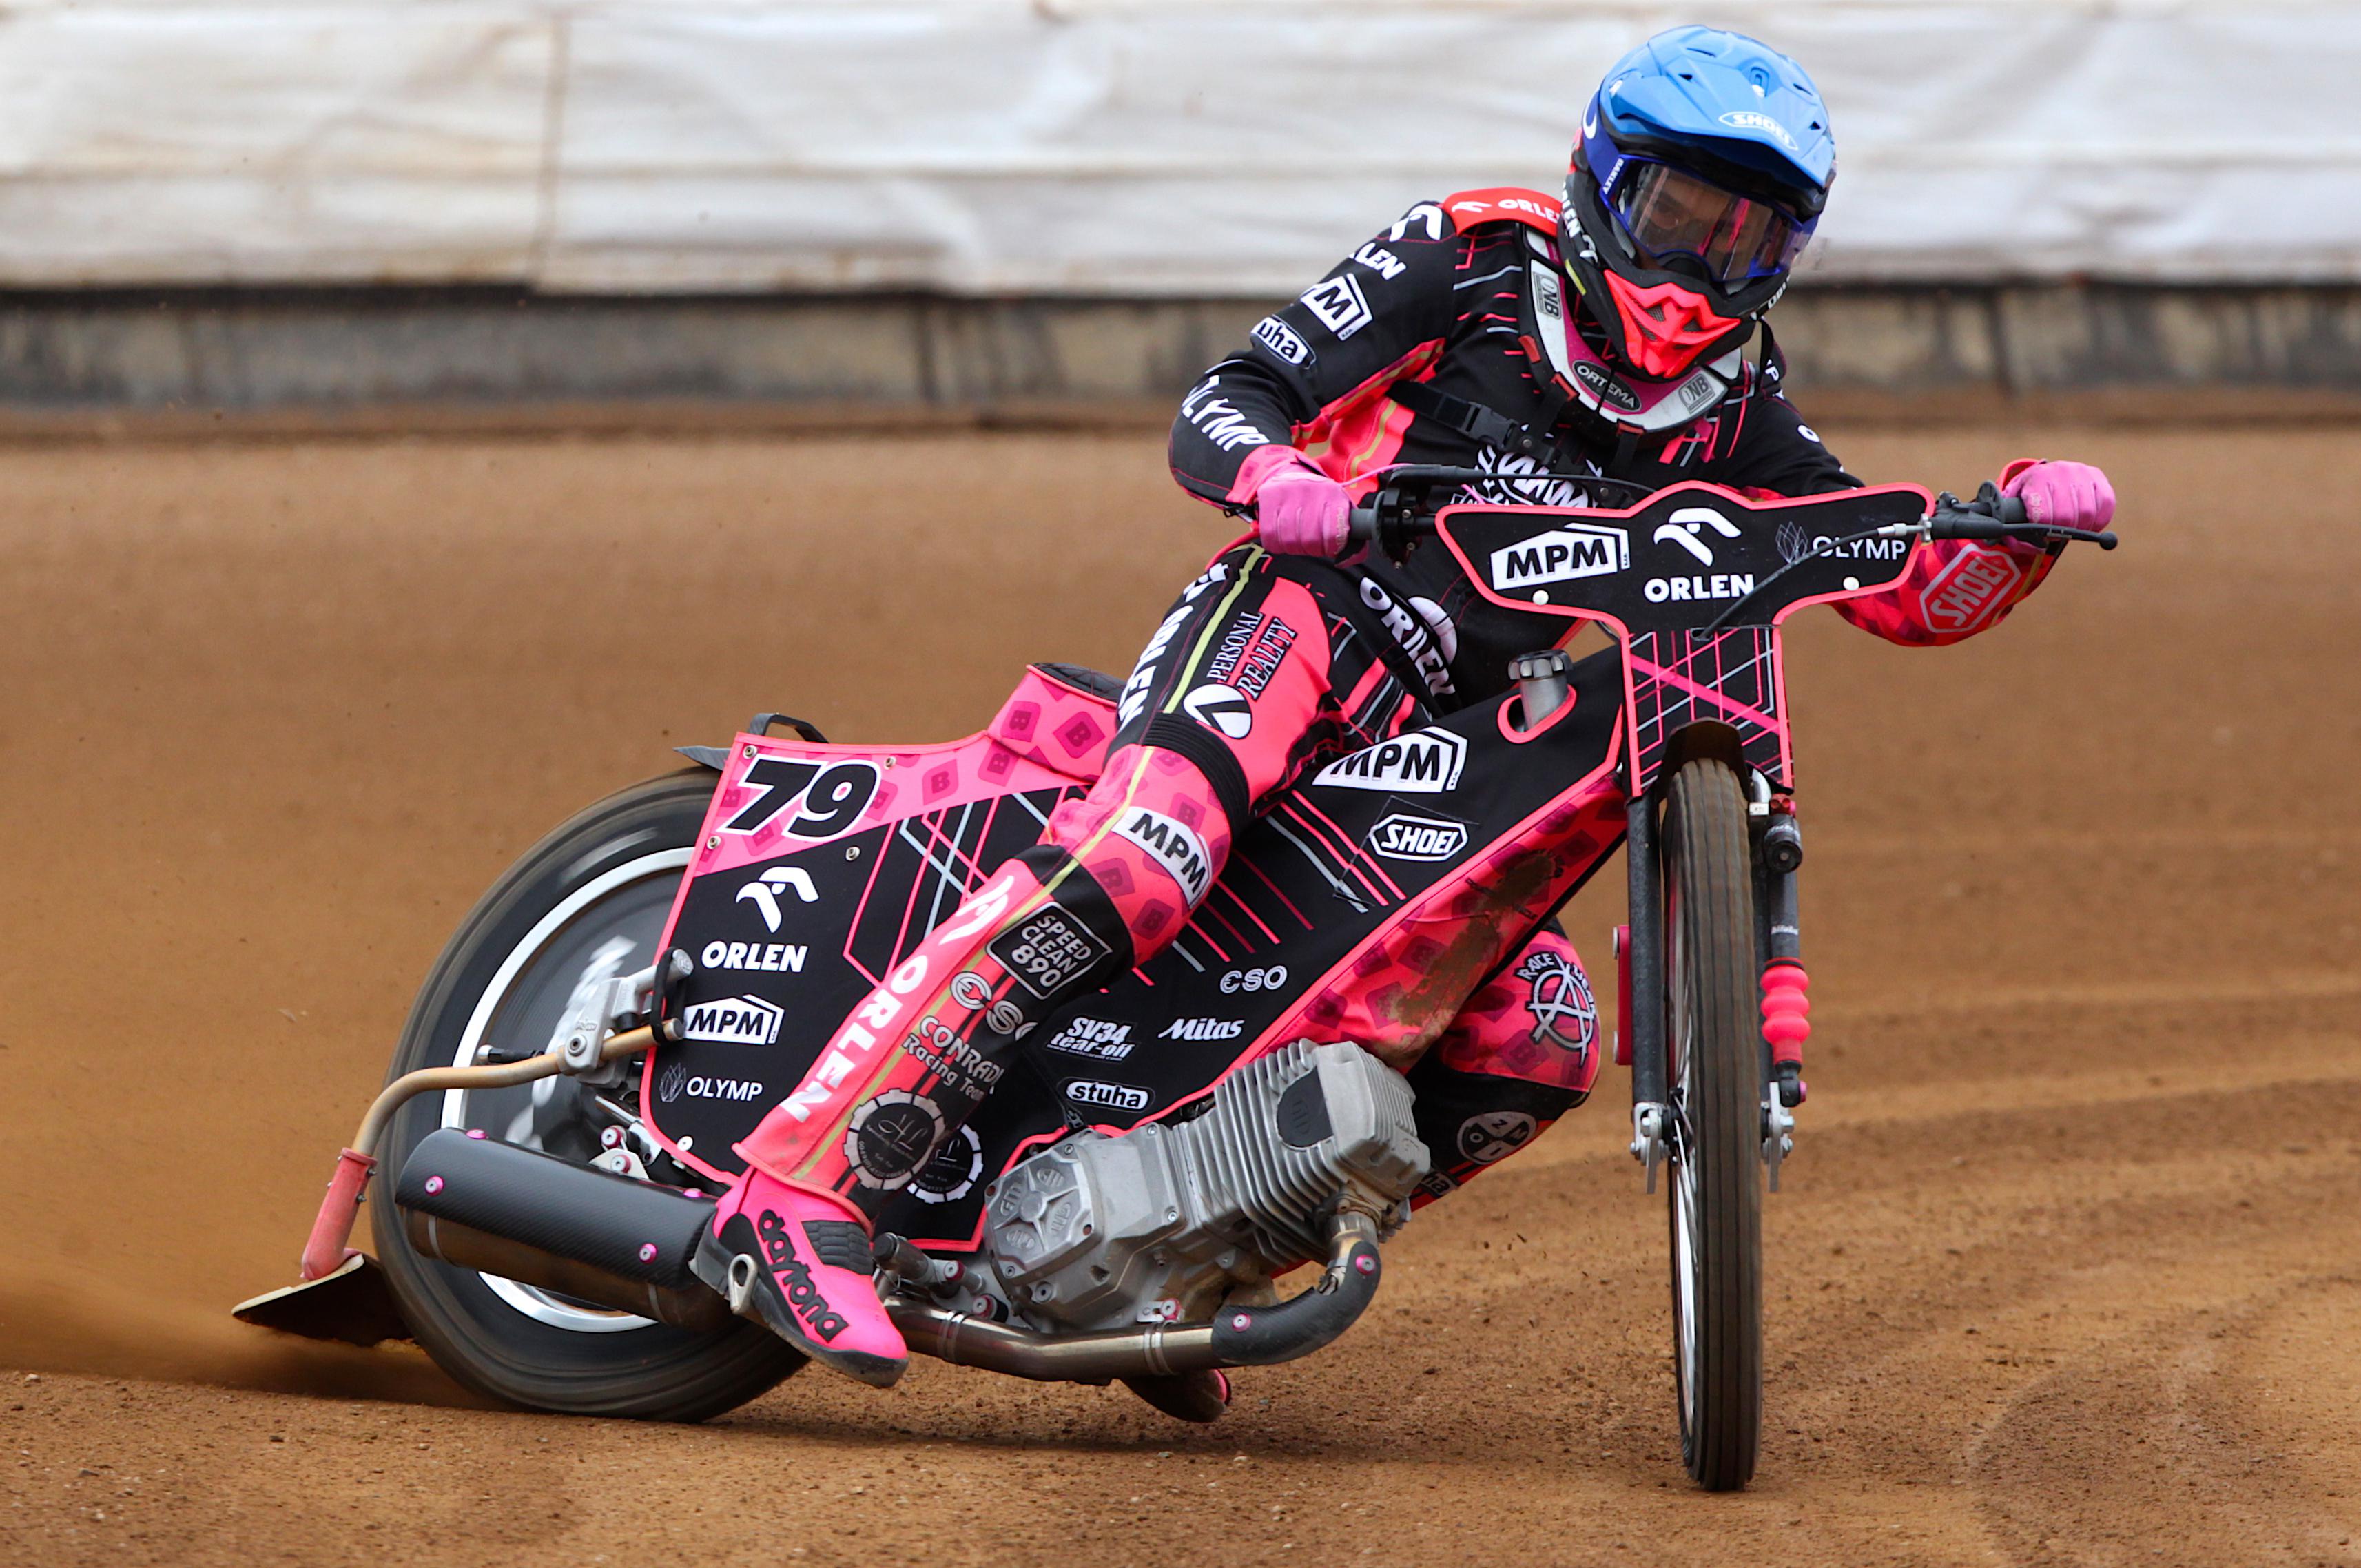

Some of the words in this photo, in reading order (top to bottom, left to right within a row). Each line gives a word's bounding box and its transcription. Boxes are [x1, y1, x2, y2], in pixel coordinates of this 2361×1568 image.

[1733, 114, 1790, 145] SHOEI
[1602, 158, 1624, 194] OAKLEY
[1498, 198, 1560, 223] ORLE
[1577, 365, 1636, 409] ORTEMA
[1507, 539, 1609, 580] MPM
[1644, 573, 1755, 603] ORLEN
[1930, 555, 2010, 626] SHOEI
[1206, 611, 1265, 681] PERSONAL
[1359, 577, 1456, 697] ORLEN
[1237, 617, 1298, 700] REALITY
[1330, 744, 1441, 781] MPM
[719, 755, 881, 841] 79
[1129, 813, 1206, 894] MPM
[1381, 823, 1460, 855] SHOEI
[701, 940, 809, 973] ORLEN
[1021, 925, 1078, 974] CLEAN
[1036, 915, 1092, 960] SPEED
[1011, 944, 1062, 988] 890
[1517, 953, 1555, 980] RACE
[689, 1009, 764, 1036] MPM
[779, 955, 928, 1123] ORLEN
[1067, 1017, 1132, 1045] SV34
[1158, 1018, 1245, 1040] Mitas
[902, 1033, 958, 1086] Racing
[1050, 1033, 1136, 1058] tear-off
[686, 1077, 763, 1102] OLYMP
[1072, 1082, 1142, 1108] stuha
[758, 1209, 849, 1343] daytona
